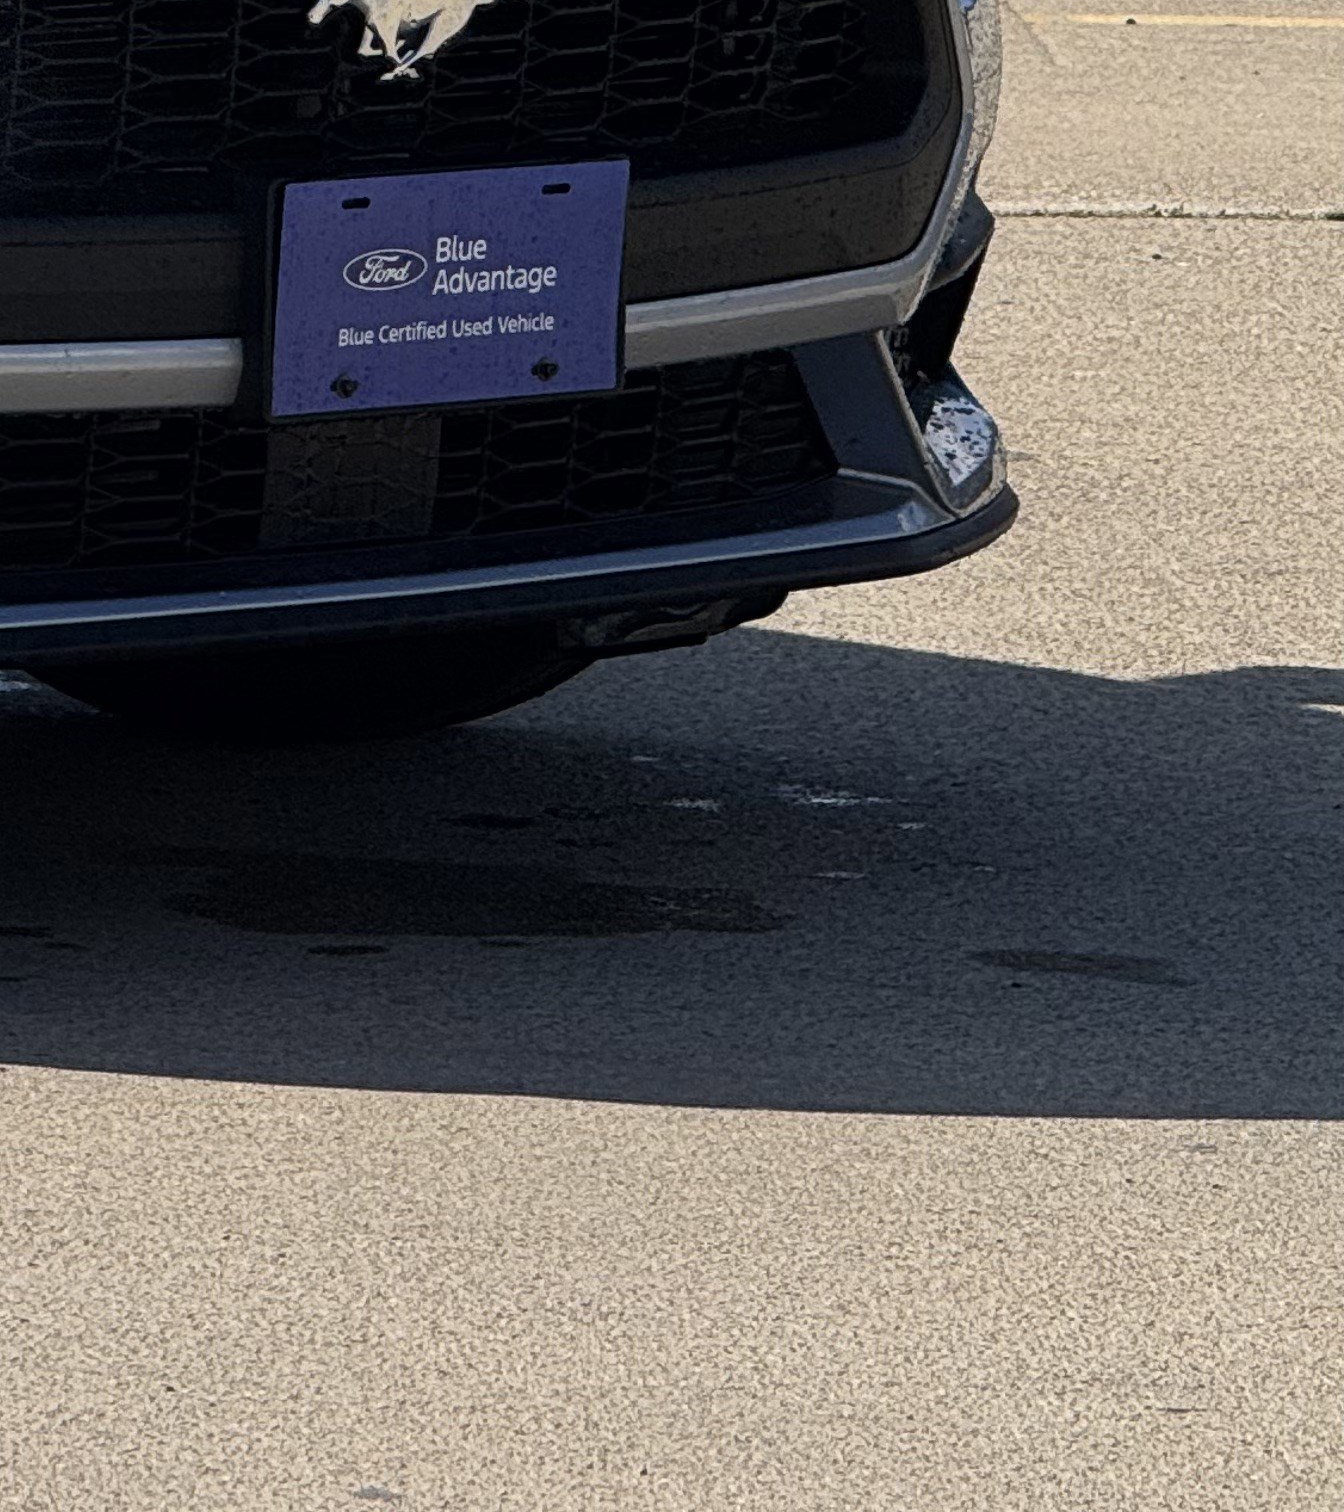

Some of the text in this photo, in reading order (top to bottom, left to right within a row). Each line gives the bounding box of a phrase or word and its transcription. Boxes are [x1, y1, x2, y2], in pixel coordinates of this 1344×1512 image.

[436, 236, 487, 263] Blue
[359, 255, 412, 285] Ford
[432, 264, 557, 296] Advantage
[338, 313, 555, 347] Blue Certified Used Vehicle
